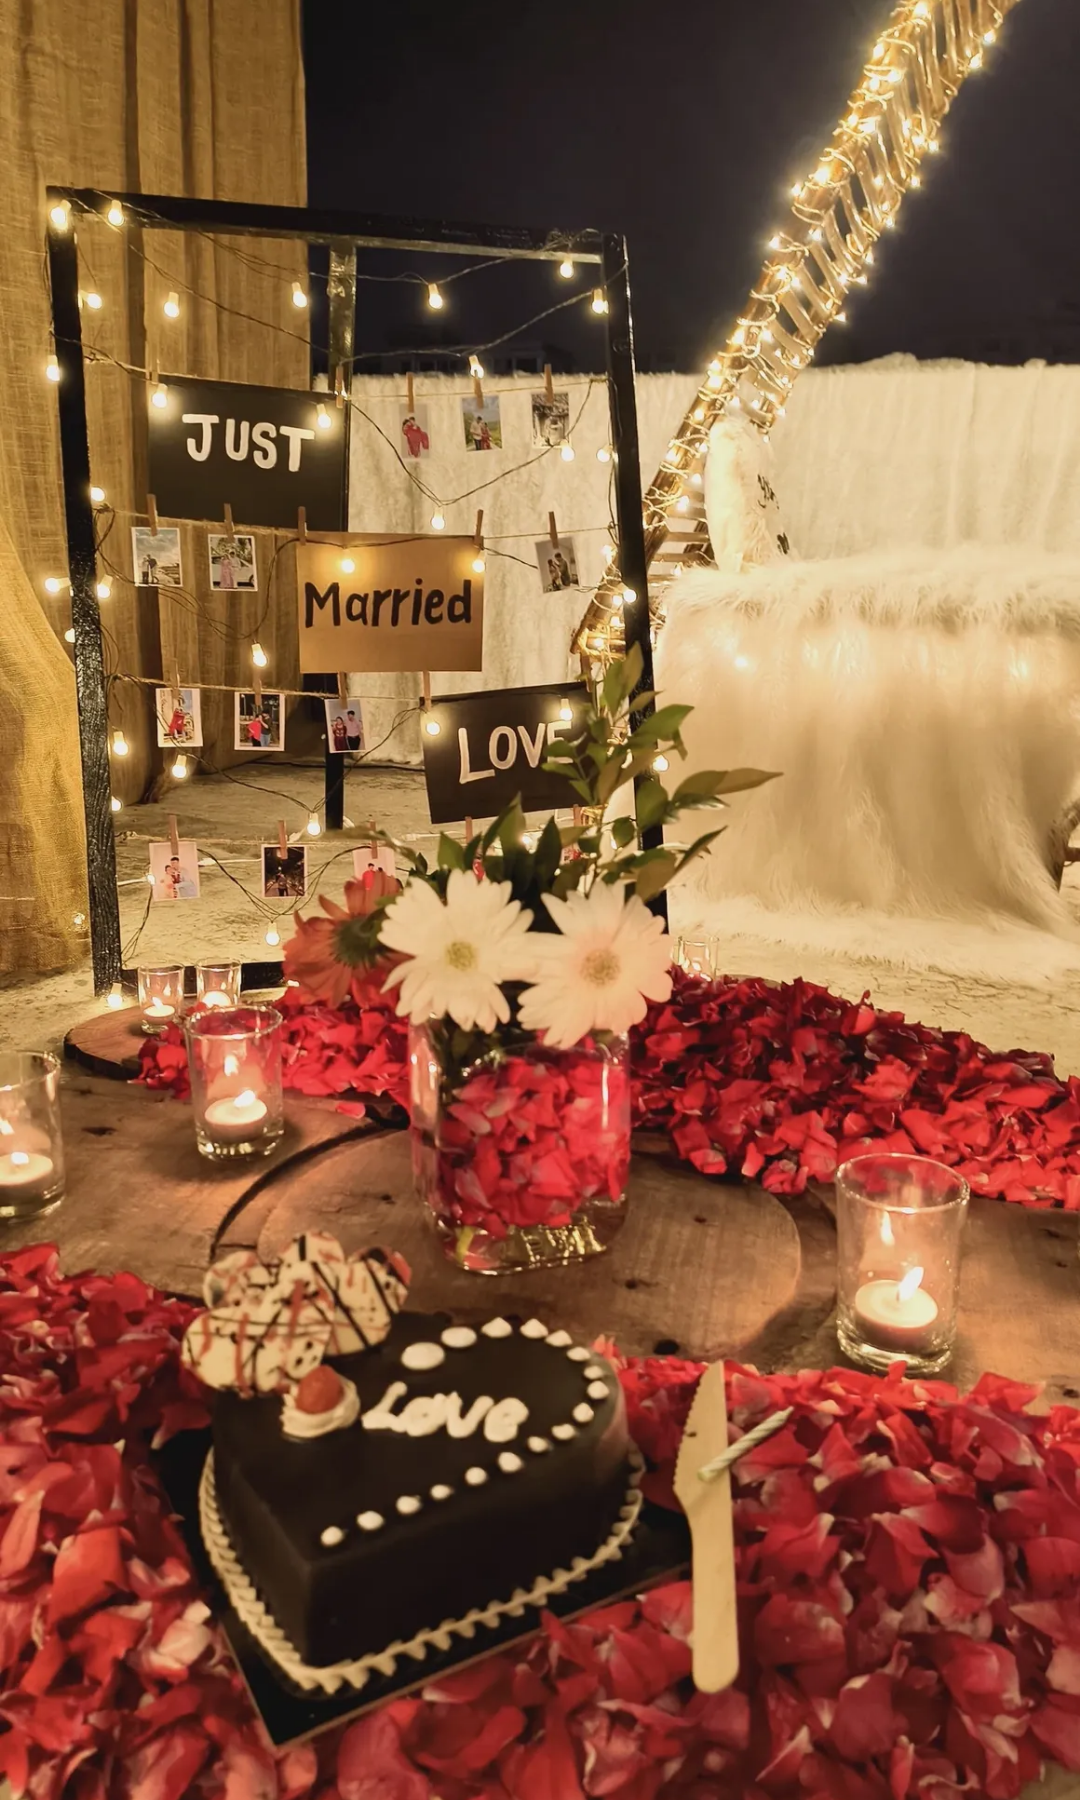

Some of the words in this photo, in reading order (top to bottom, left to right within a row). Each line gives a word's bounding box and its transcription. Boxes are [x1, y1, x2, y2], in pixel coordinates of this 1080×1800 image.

[182, 413, 315, 472] JUST
[304, 578, 472, 628] Married
[458, 720, 574, 784] LOVE
[361, 1381, 529, 1442] Love
